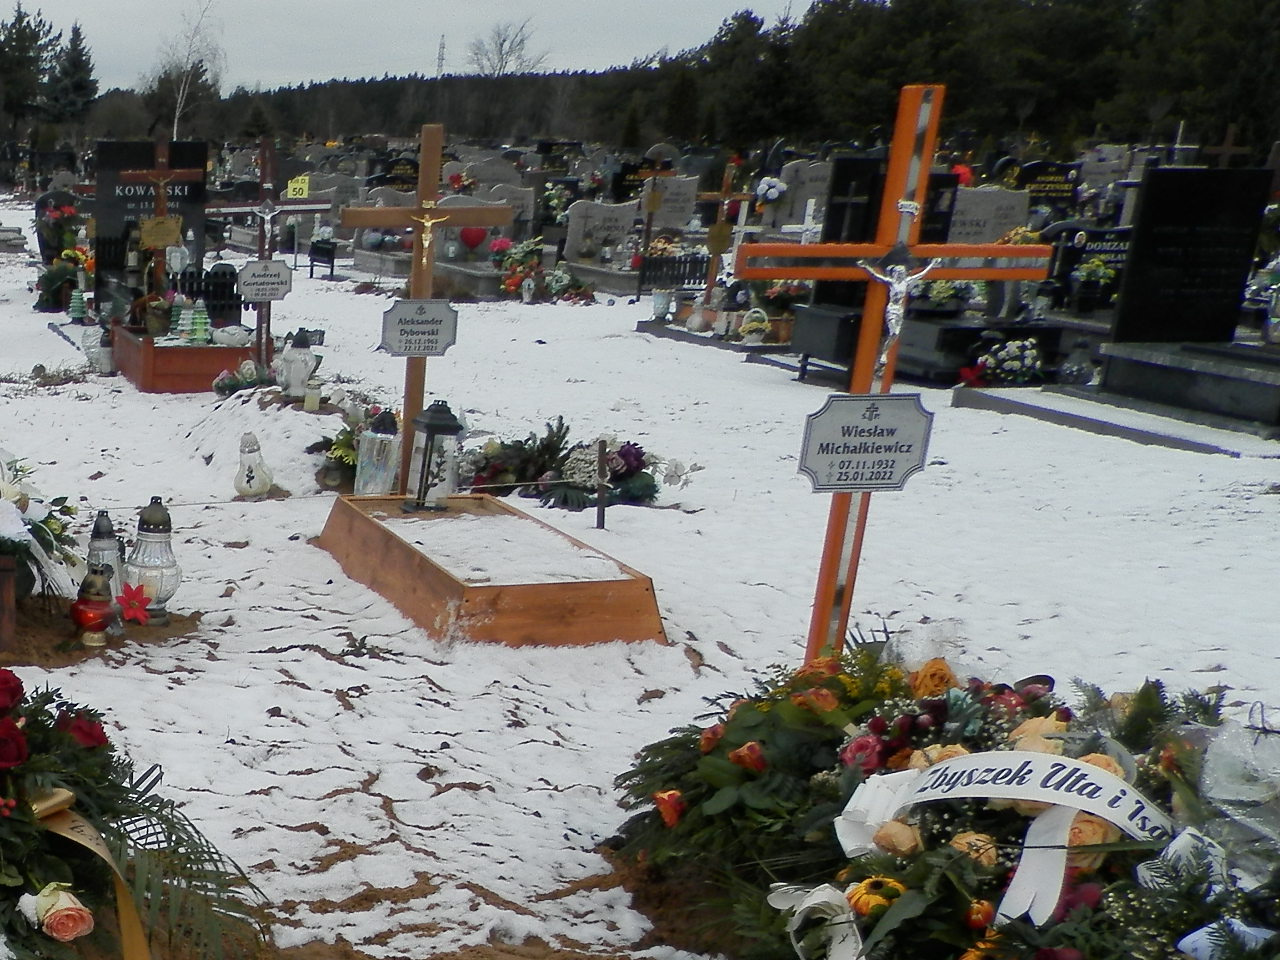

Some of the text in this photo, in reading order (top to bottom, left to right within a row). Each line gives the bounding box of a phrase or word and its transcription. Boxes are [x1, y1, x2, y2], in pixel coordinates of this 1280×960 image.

[115, 186, 189, 196] KOWASKI
[291, 187, 304, 196] 50
[397, 318, 443, 326] Aleksander
[400, 328, 439, 337] Dybowski
[841, 425, 897, 438] Wiesław
[817, 441, 913, 455] Michałkiewicz
[838, 460, 896, 470] 07.11.1932
[836, 471, 893, 481] 25.01.2022
[1107, 789, 1128, 809] i
